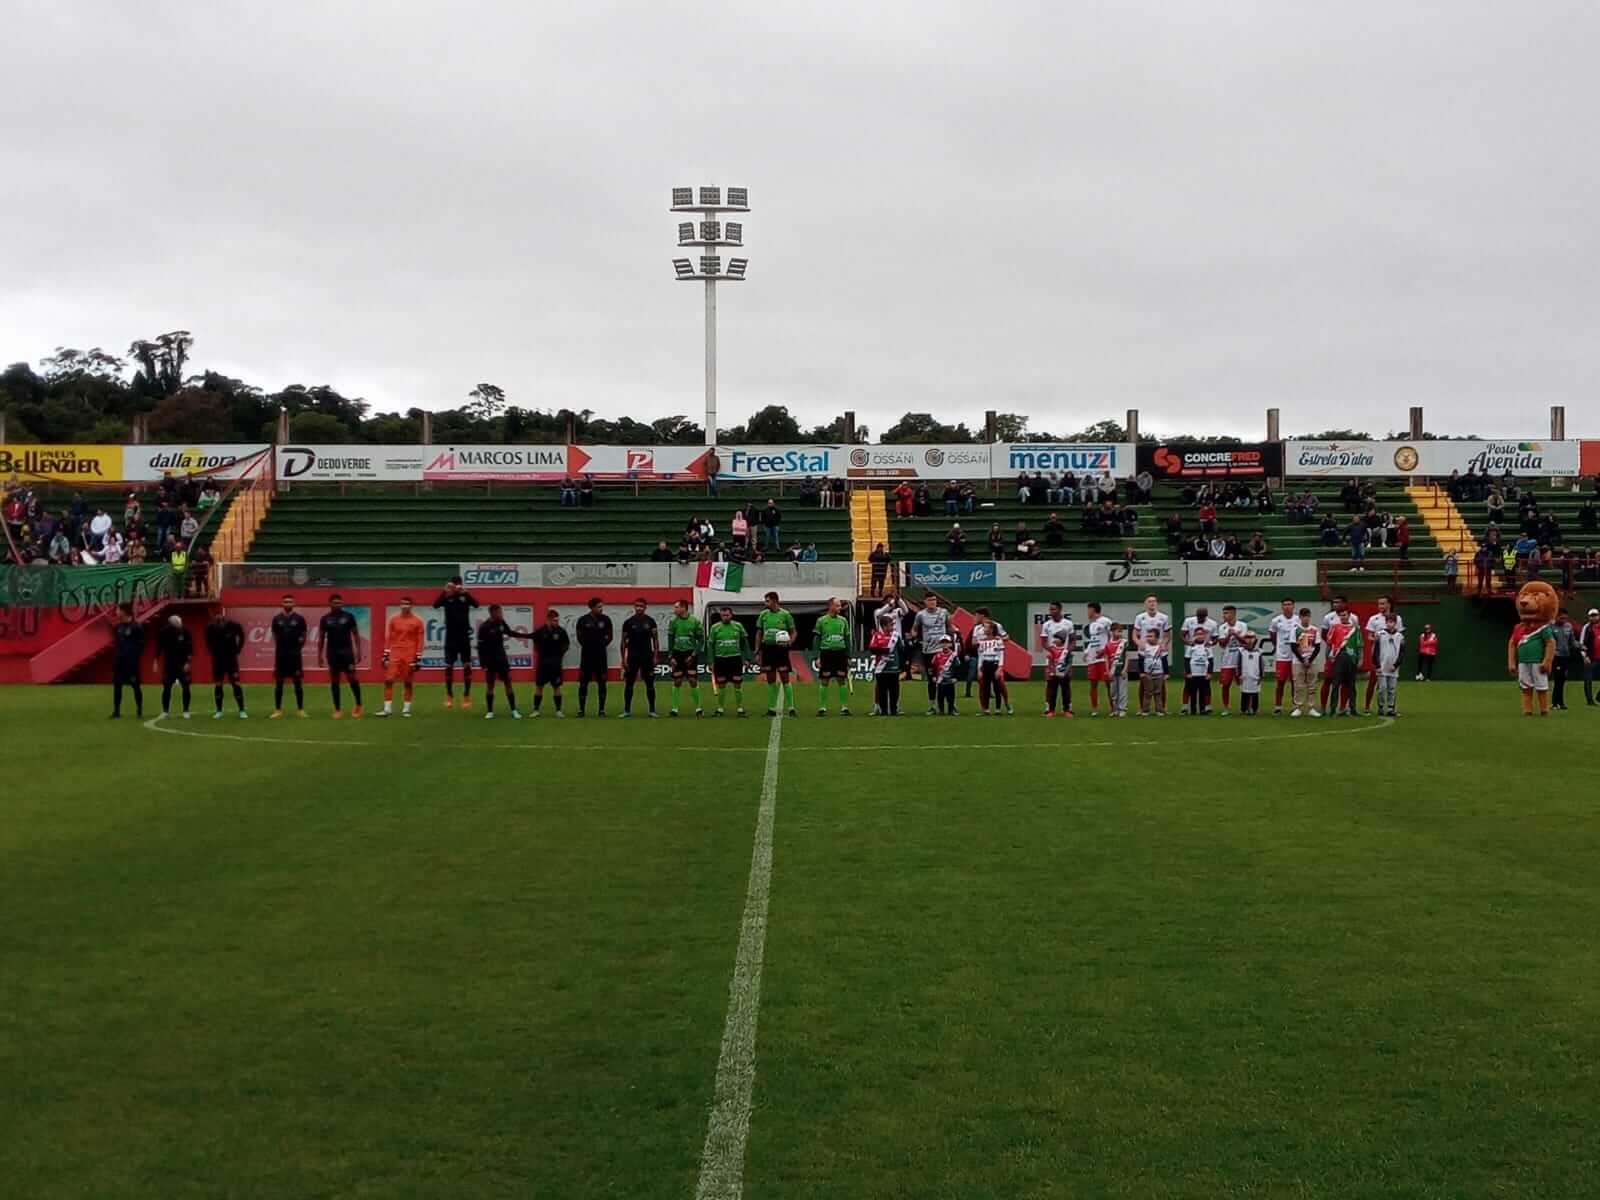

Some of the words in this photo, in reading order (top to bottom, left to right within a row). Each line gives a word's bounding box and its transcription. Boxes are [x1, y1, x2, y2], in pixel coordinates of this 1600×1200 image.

[40, 449, 76, 458] PNEUS
[1486, 443, 1517, 455] Posto
[150, 453, 192, 468] dalla
[197, 455, 237, 467] nora
[459, 451, 523, 465] MARCOS
[527, 451, 564, 465] LIMA
[732, 451, 829, 472] FreeStal
[873, 454, 914, 465] OSSANI
[947, 454, 989, 465] OSSANI
[1468, 451, 1543, 472] Avenida
[465, 571, 517, 584] SILVA
[1219, 565, 1251, 578] dalla
[1255, 567, 1285, 578] nora
